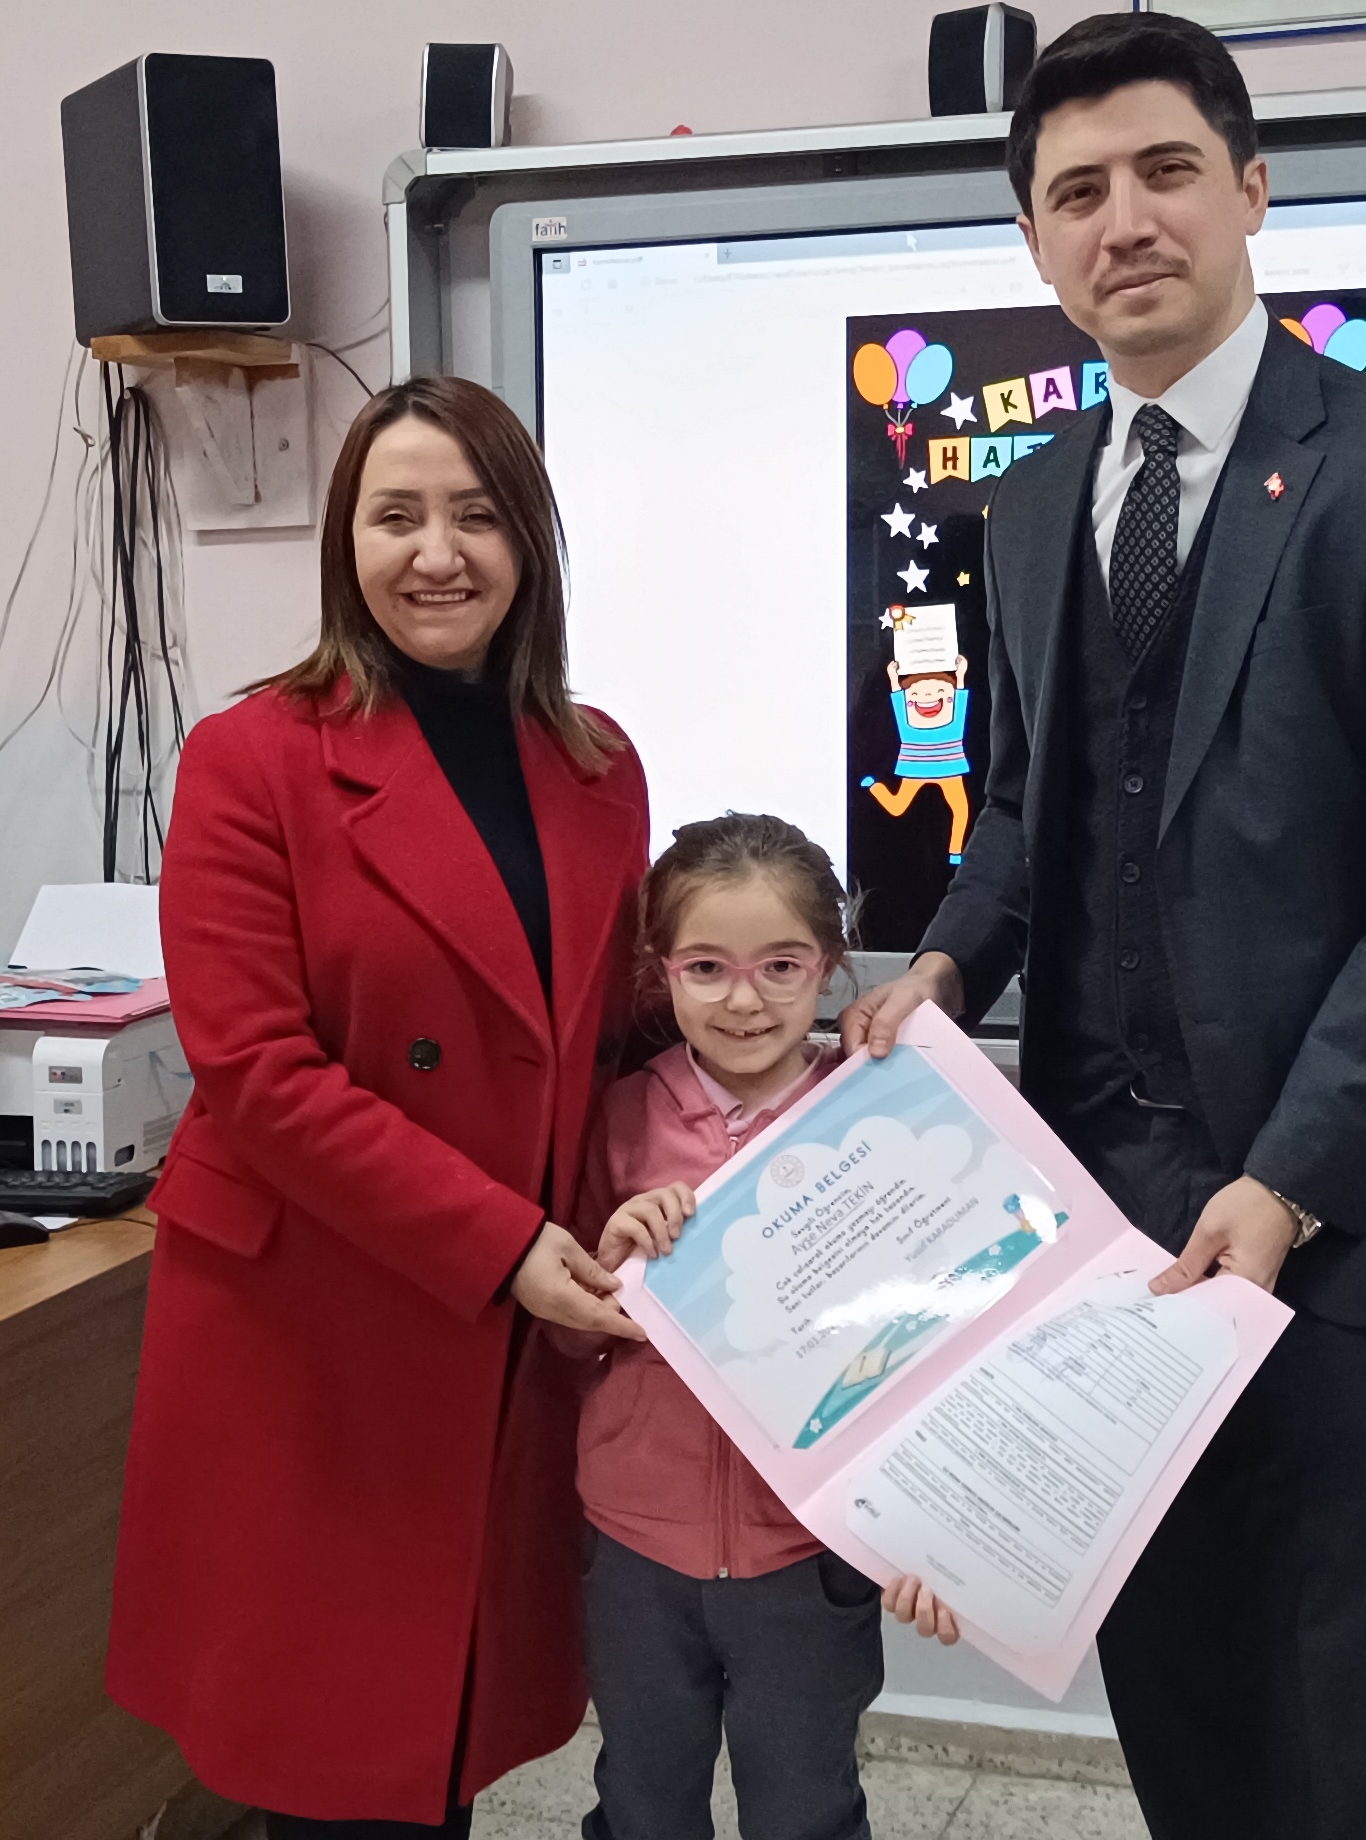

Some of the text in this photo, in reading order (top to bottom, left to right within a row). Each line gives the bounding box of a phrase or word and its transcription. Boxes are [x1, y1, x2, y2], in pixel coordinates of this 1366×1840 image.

[942, 443, 1043, 471] HA
[762, 1194, 814, 1239] OKUMA
[814, 1140, 873, 1194] BELGESİ
[791, 1180, 874, 1255] Ayşe Neva TEKİN
